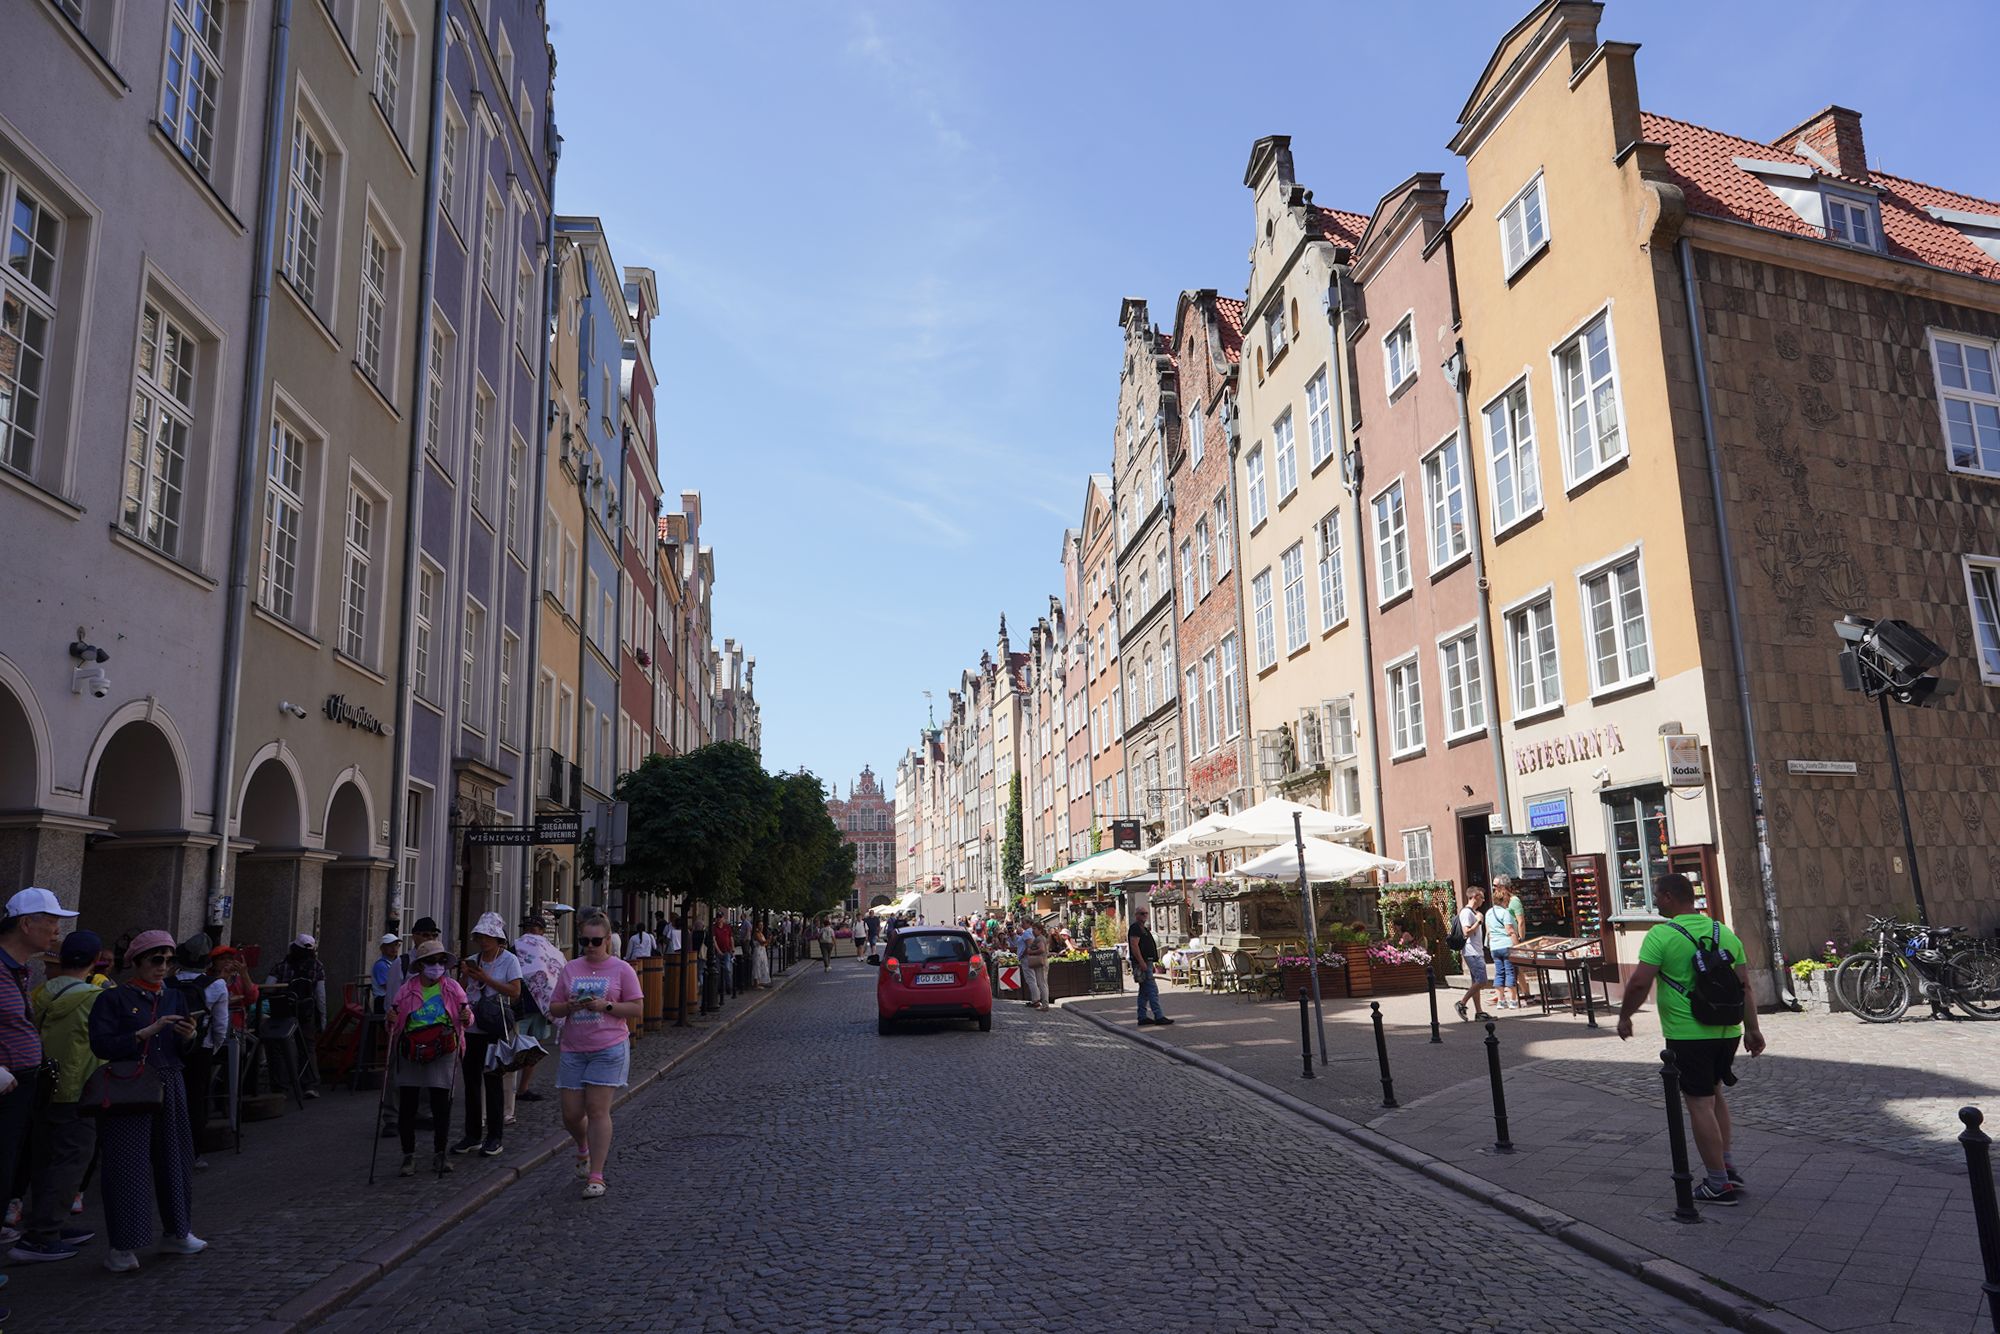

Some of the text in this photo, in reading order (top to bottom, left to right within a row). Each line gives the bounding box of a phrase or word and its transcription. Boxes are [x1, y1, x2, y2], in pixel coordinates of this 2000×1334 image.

[1672, 767, 1701, 775] Kodak
[539, 822, 578, 831] SIEGARNIA
[470, 832, 531, 842] WIŚNIEWSKI
[540, 830, 576, 839] SOUVENIRS
